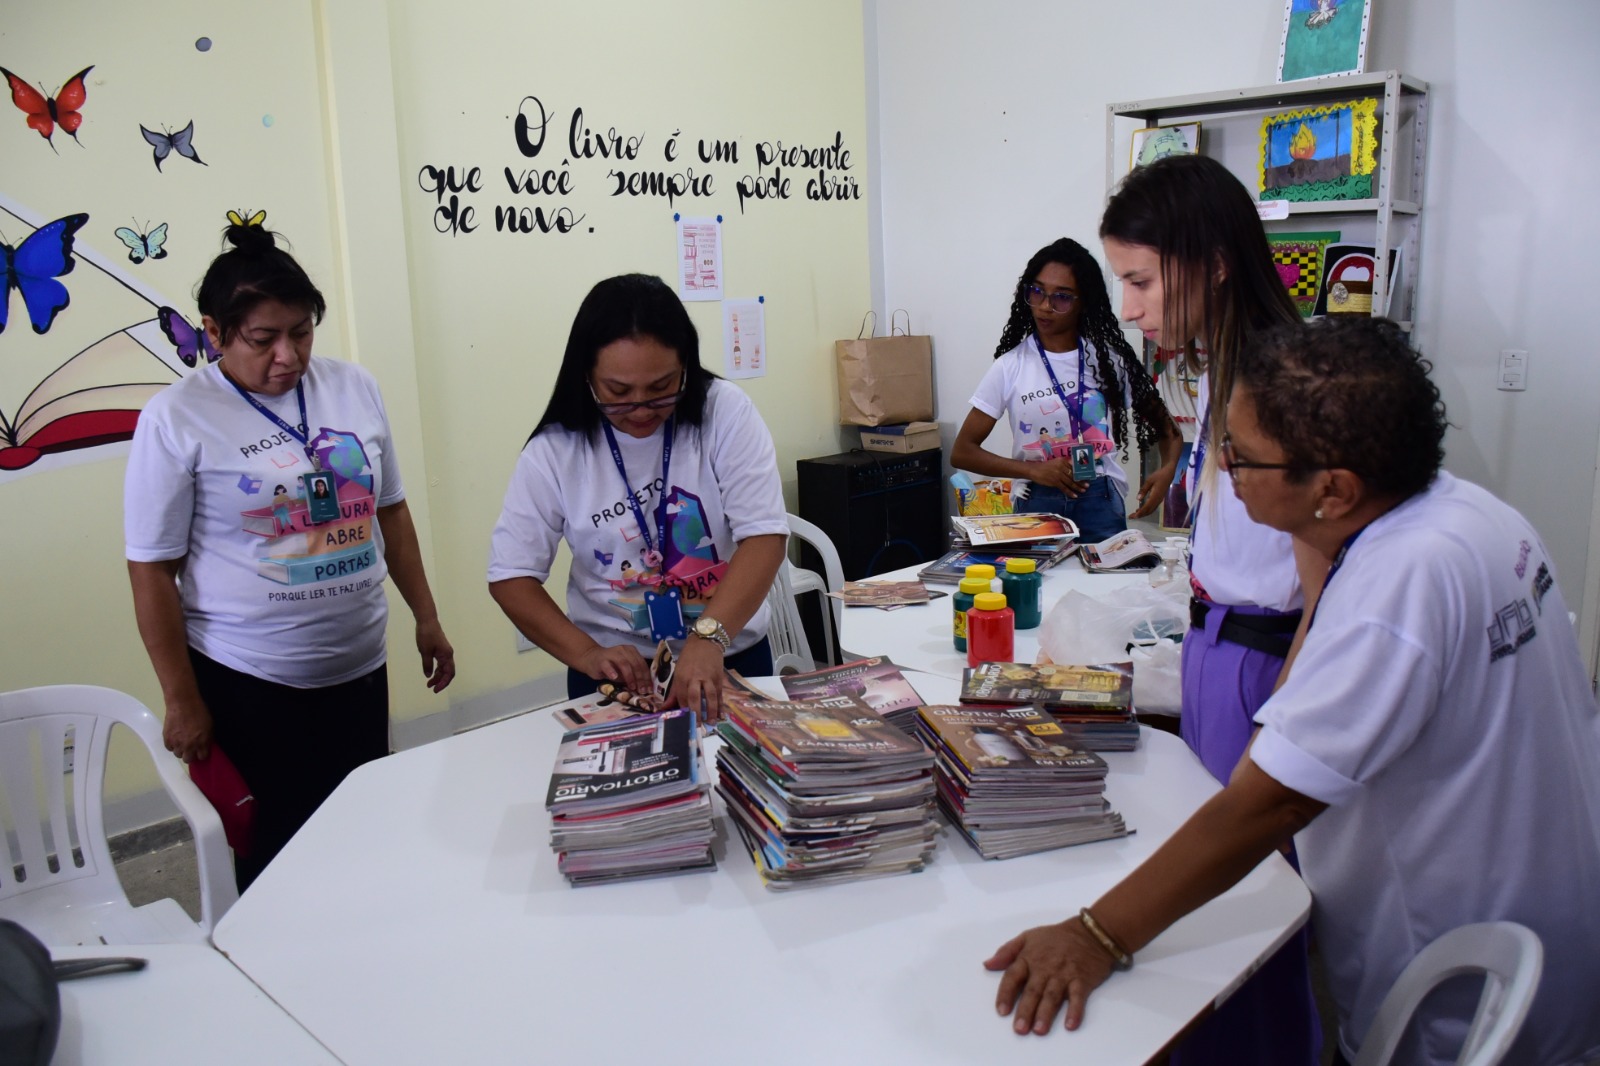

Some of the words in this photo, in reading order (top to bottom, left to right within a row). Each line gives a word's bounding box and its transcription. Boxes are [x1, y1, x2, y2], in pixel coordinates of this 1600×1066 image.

[514, 95, 555, 158] O
[569, 107, 645, 161] livro
[664, 129, 681, 163] é
[698, 137, 739, 164] um
[755, 131, 855, 174] presente
[418, 164, 485, 204] que
[504, 157, 576, 195] você
[606, 166, 717, 208] sempre
[736, 167, 793, 215] pode
[806, 171, 863, 201] abrir
[433, 195, 481, 238] de
[495, 205, 595, 234] novo.
[1021, 380, 1076, 405] PROJETO
[240, 423, 310, 459] PROJEO
[302, 501, 370, 527] LURA
[326, 526, 364, 546] ABRE
[315, 551, 370, 580] PORTAS
[269, 592, 307, 602] PORQUE
[309, 589, 325, 600] LER
[327, 587, 338, 598] TE
[340, 583, 355, 595] FAZ
